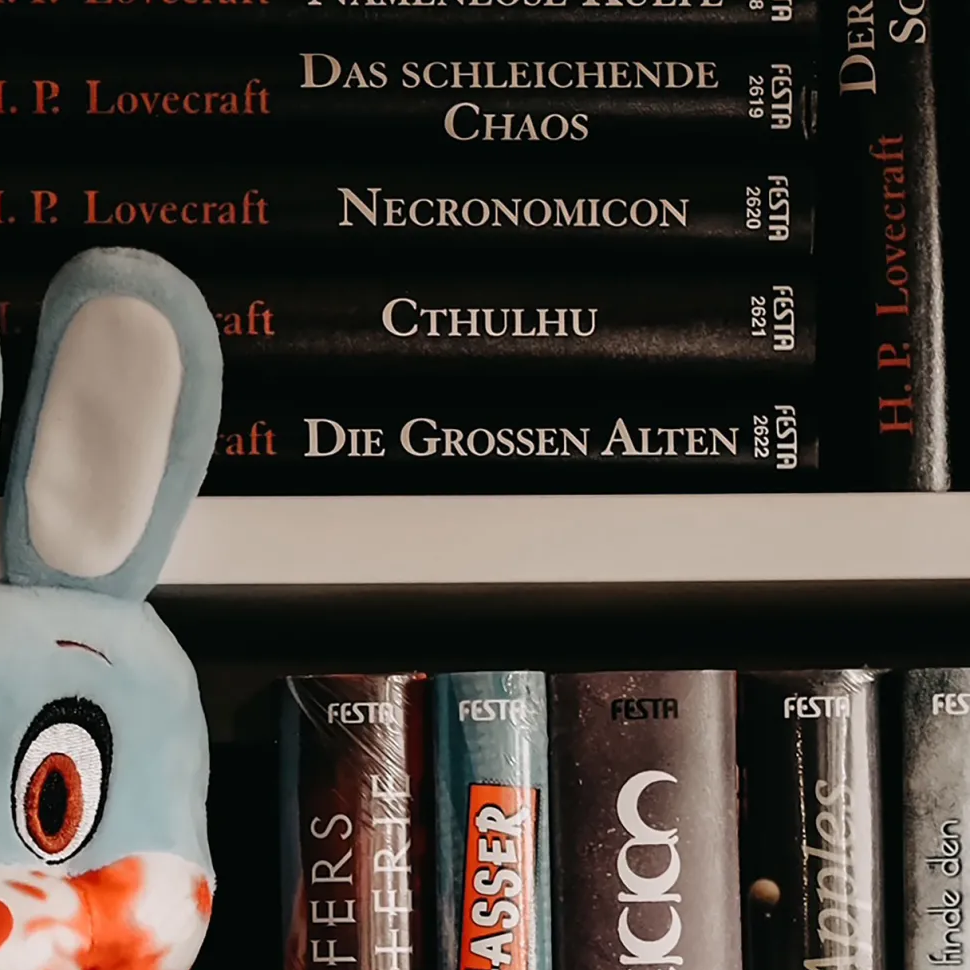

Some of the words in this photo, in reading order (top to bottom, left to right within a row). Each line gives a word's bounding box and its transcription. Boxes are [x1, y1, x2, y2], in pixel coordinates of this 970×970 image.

[839, 0, 877, 96] DER
[299, 52, 388, 89] DAS
[401, 60, 720, 89] SCHLEICHENDE
[32, 80, 60, 115] P.
[85, 78, 271, 115] Lovecraft
[748, 75, 764, 119] 2619
[771, 63, 793, 130] FESTA
[444, 102, 588, 141] CHAOS
[31, 190, 58, 225] P.
[84, 188, 270, 225] Lovecraft
[338, 187, 689, 227] NECRONOMICON
[746, 186, 762, 230] 2620
[768, 175, 790, 241] FESTA
[868, 134, 910, 316] Lovecraft
[382, 298, 598, 337] CTHULHU
[750, 296, 766, 338] 2621
[773, 285, 795, 351] FESTA
[877, 343, 912, 370] P.
[878, 384, 914, 435] H.
[303, 418, 386, 458] DIE
[400, 418, 590, 458] GROSSEN
[601, 418, 740, 457] ALTEN
[753, 415, 769, 458] 2622
[774, 404, 798, 470] FESTA
[328, 702, 396, 724] FESTA
[459, 698, 527, 722] FESTA
[611, 698, 679, 721] FESTA
[784, 696, 851, 719] FESTA
[926, 819, 962, 877] den
[926, 889, 962, 966] finde
